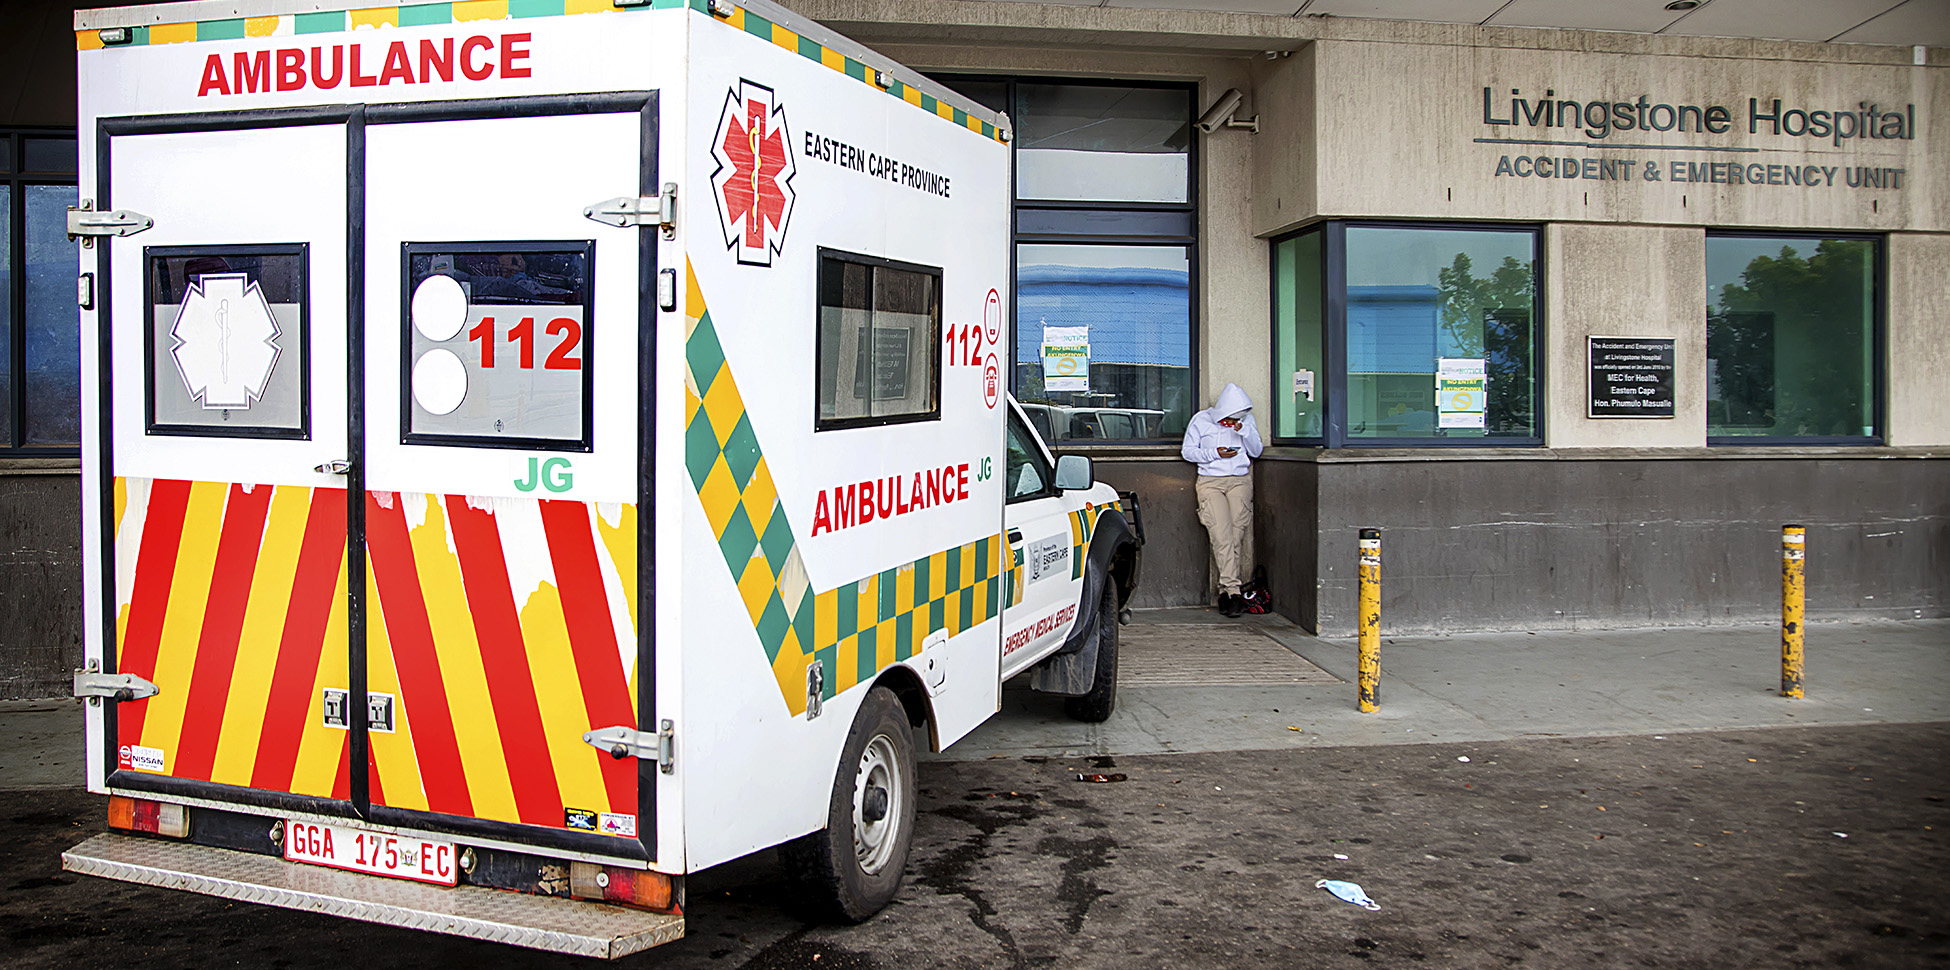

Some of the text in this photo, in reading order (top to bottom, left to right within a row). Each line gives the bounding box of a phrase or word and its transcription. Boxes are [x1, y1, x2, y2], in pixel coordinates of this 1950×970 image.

[197, 33, 532, 97] AMBULANCE
[1484, 87, 1915, 147] Livingstone Hospital
[805, 131, 951, 198] EASTERN CAPE PROVINCE
[1495, 155, 1905, 189] ACCIDENT & EMERGENCY UNIT
[468, 316, 582, 371] 112
[946, 323, 982, 367] 112
[1636, 343, 1663, 351] Emergency
[1611, 386, 1656, 396] Eastern Cape
[1635, 374, 1659, 383] Health,
[1594, 399, 1610, 407] Hon.
[1611, 399, 1641, 407] Phumulo
[514, 457, 574, 493] JG
[976, 455, 992, 483] JG
[811, 463, 969, 538] AMBULANCE
[1043, 547, 1068, 565] EASTERN CAPE
[1003, 603, 1076, 657] EMERGENCY MEDICAL SERVICES
[132, 756, 164, 766] NISSAN
[293, 823, 450, 878] GGA 175 EC
